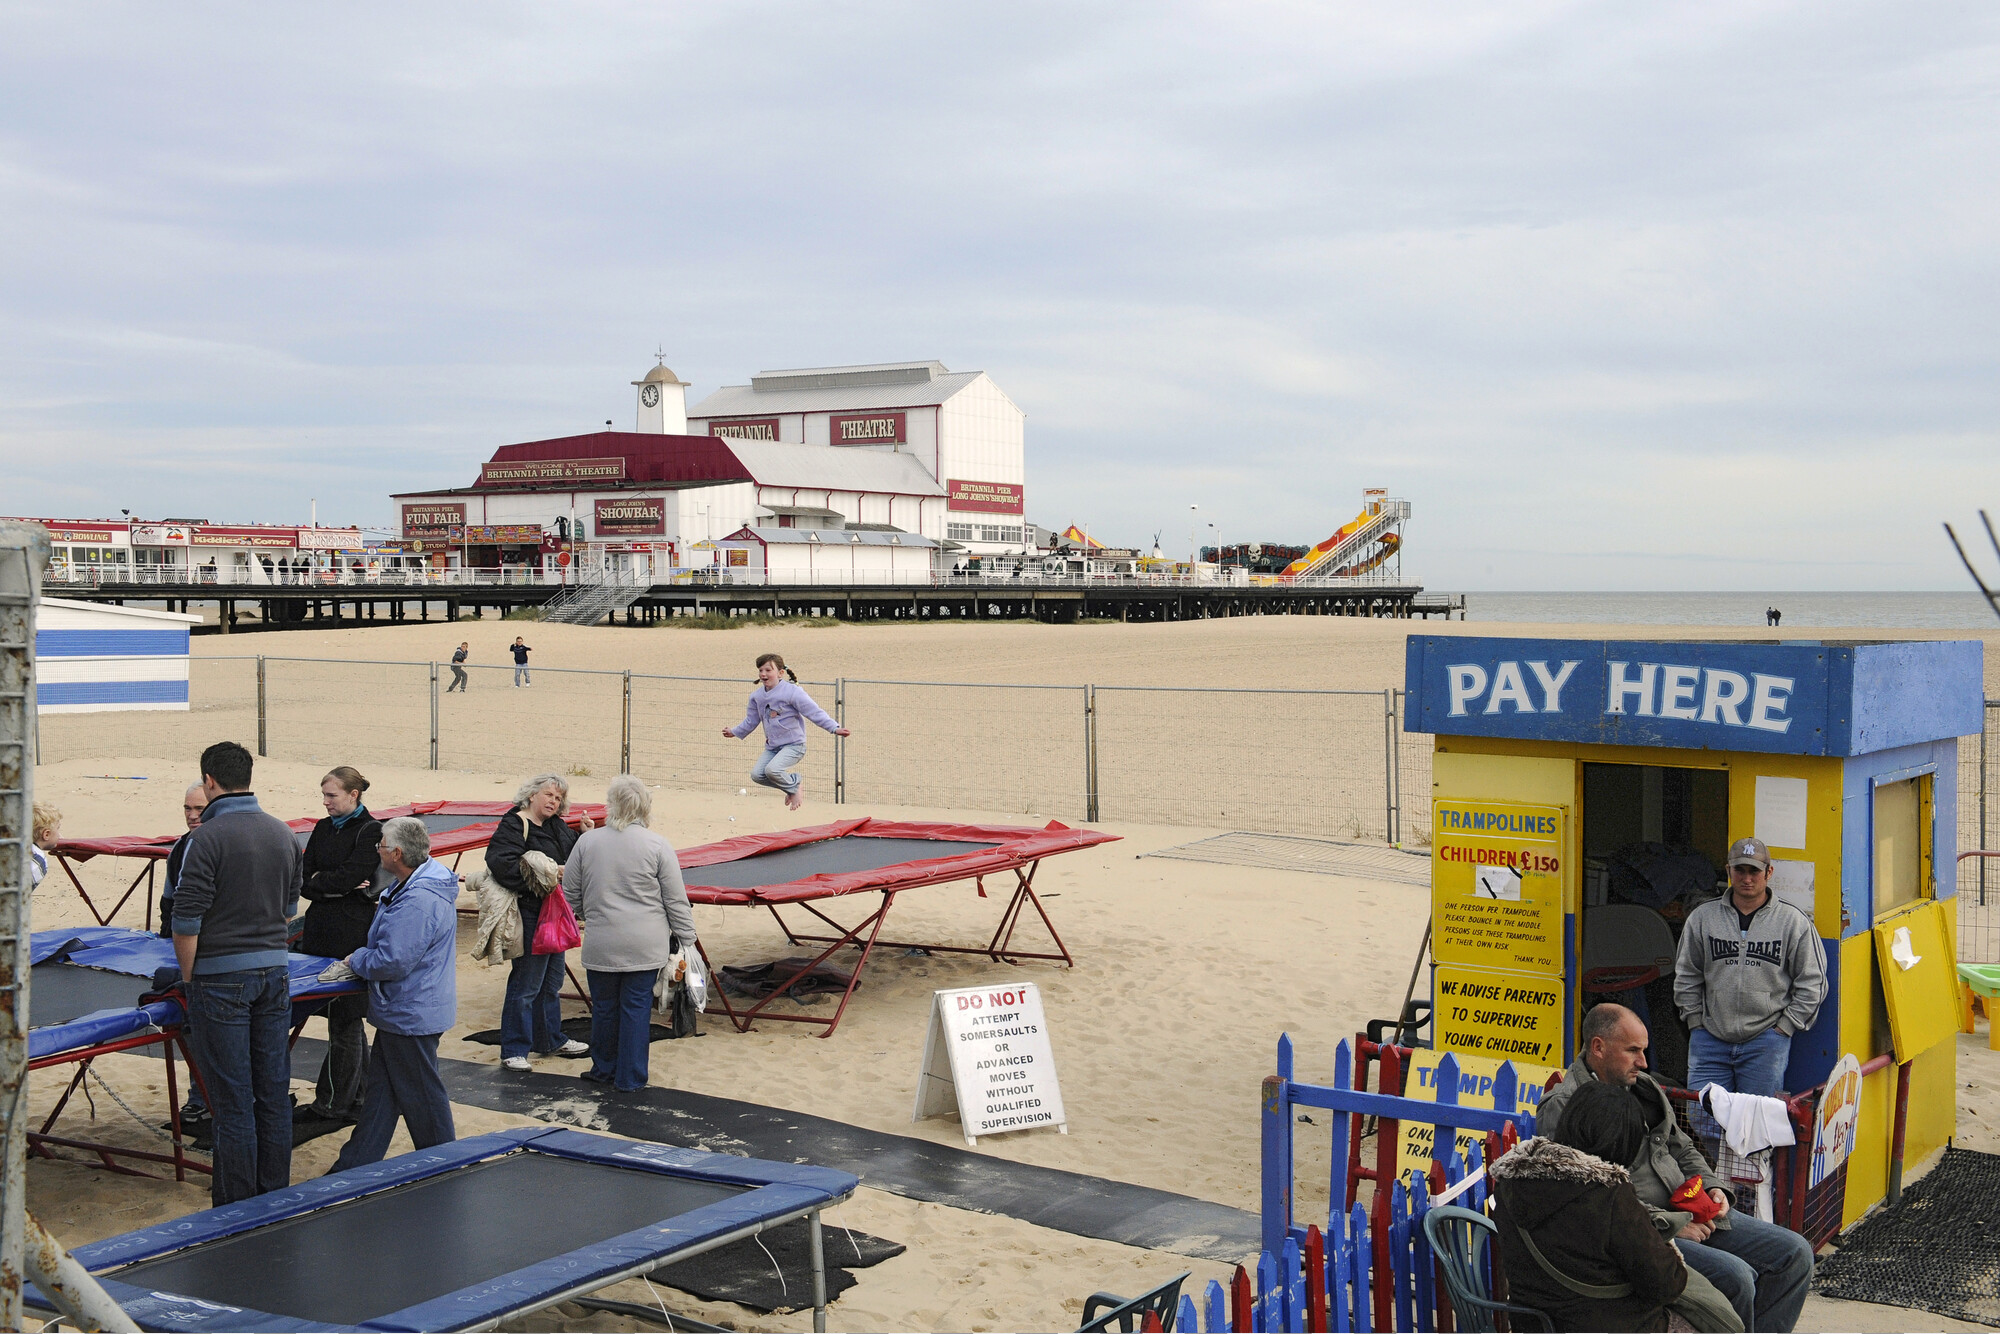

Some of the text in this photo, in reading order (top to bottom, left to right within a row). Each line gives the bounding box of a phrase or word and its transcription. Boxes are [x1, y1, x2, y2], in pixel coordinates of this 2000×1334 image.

[713, 424, 775, 441] BRITANNIA
[840, 418, 895, 440] THEATRE
[486, 466, 620, 479] BRITANNIA PIER & THEATRE
[952, 491, 969, 500] LONG
[960, 484, 1012, 495] BRITANNIA PIER
[405, 512, 462, 525] FUN FAIR
[600, 506, 659, 519] SHOWBAR
[72, 532, 109, 541] BOWLING
[254, 538, 292, 546] Corner
[1261, 545, 1303, 561] TRAIN
[1446, 660, 1796, 734] PAY HERE
[1440, 810, 1556, 834] TRAMPOLINES
[1440, 845, 1517, 867] CHILDREN
[1444, 902, 1458, 910] ONE
[1460, 903, 1485, 912] PERSON
[1487, 905, 1499, 914] PER
[1444, 914, 1466, 923] PLEASE
[1468, 916, 1493, 925] BOUNCE
[1494, 918, 1502, 926] IN
[1504, 919, 1516, 927] THE
[1444, 926, 1470, 935] PERSONS
[1486, 930, 1503, 939] THESE
[1505, 932, 1546, 943] TRAMPOLINES
[1456, 939, 1473, 947] THEIR
[1476, 940, 1493, 949] OWN
[1708, 935, 1782, 961] LONSDALE
[1514, 955, 1535, 963] THANK
[1725, 959, 1761, 967] LONDON
[956, 990, 1026, 1011] DO NOT
[1441, 981, 1557, 1007] WE ADVISE PARENTS
[972, 1012, 1020, 1026] ATTEMPT
[1451, 1007, 1539, 1030] TO SUPERVISE
[960, 1025, 1038, 1042] SOMERSAULTS
[1444, 1031, 1484, 1048] YOUNG
[994, 1043, 1010, 1053] OR
[976, 1055, 1034, 1070] ADVANCED
[989, 1070, 1027, 1083] MOVES
[985, 1084, 1035, 1098] WITHOUT
[986, 1098, 1042, 1114] QUALIFIED
[981, 1111, 1052, 1130] SUPERVISION
